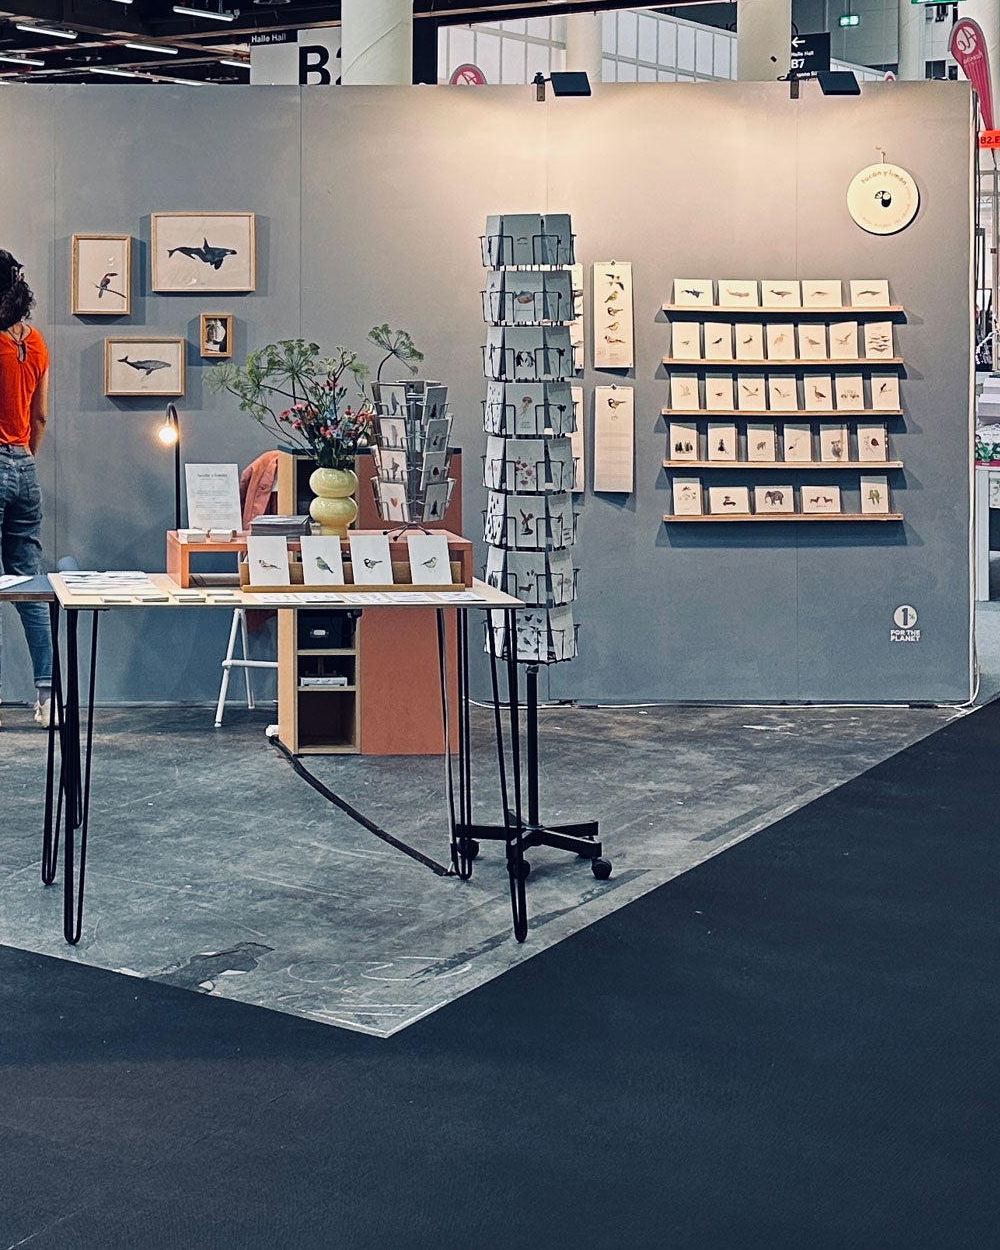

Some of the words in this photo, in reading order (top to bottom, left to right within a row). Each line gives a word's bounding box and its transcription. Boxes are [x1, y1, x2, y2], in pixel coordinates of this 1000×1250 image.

[271, 32, 287, 41] Hall
[299, 45, 341, 85] B
[791, 58, 805, 69] B7
